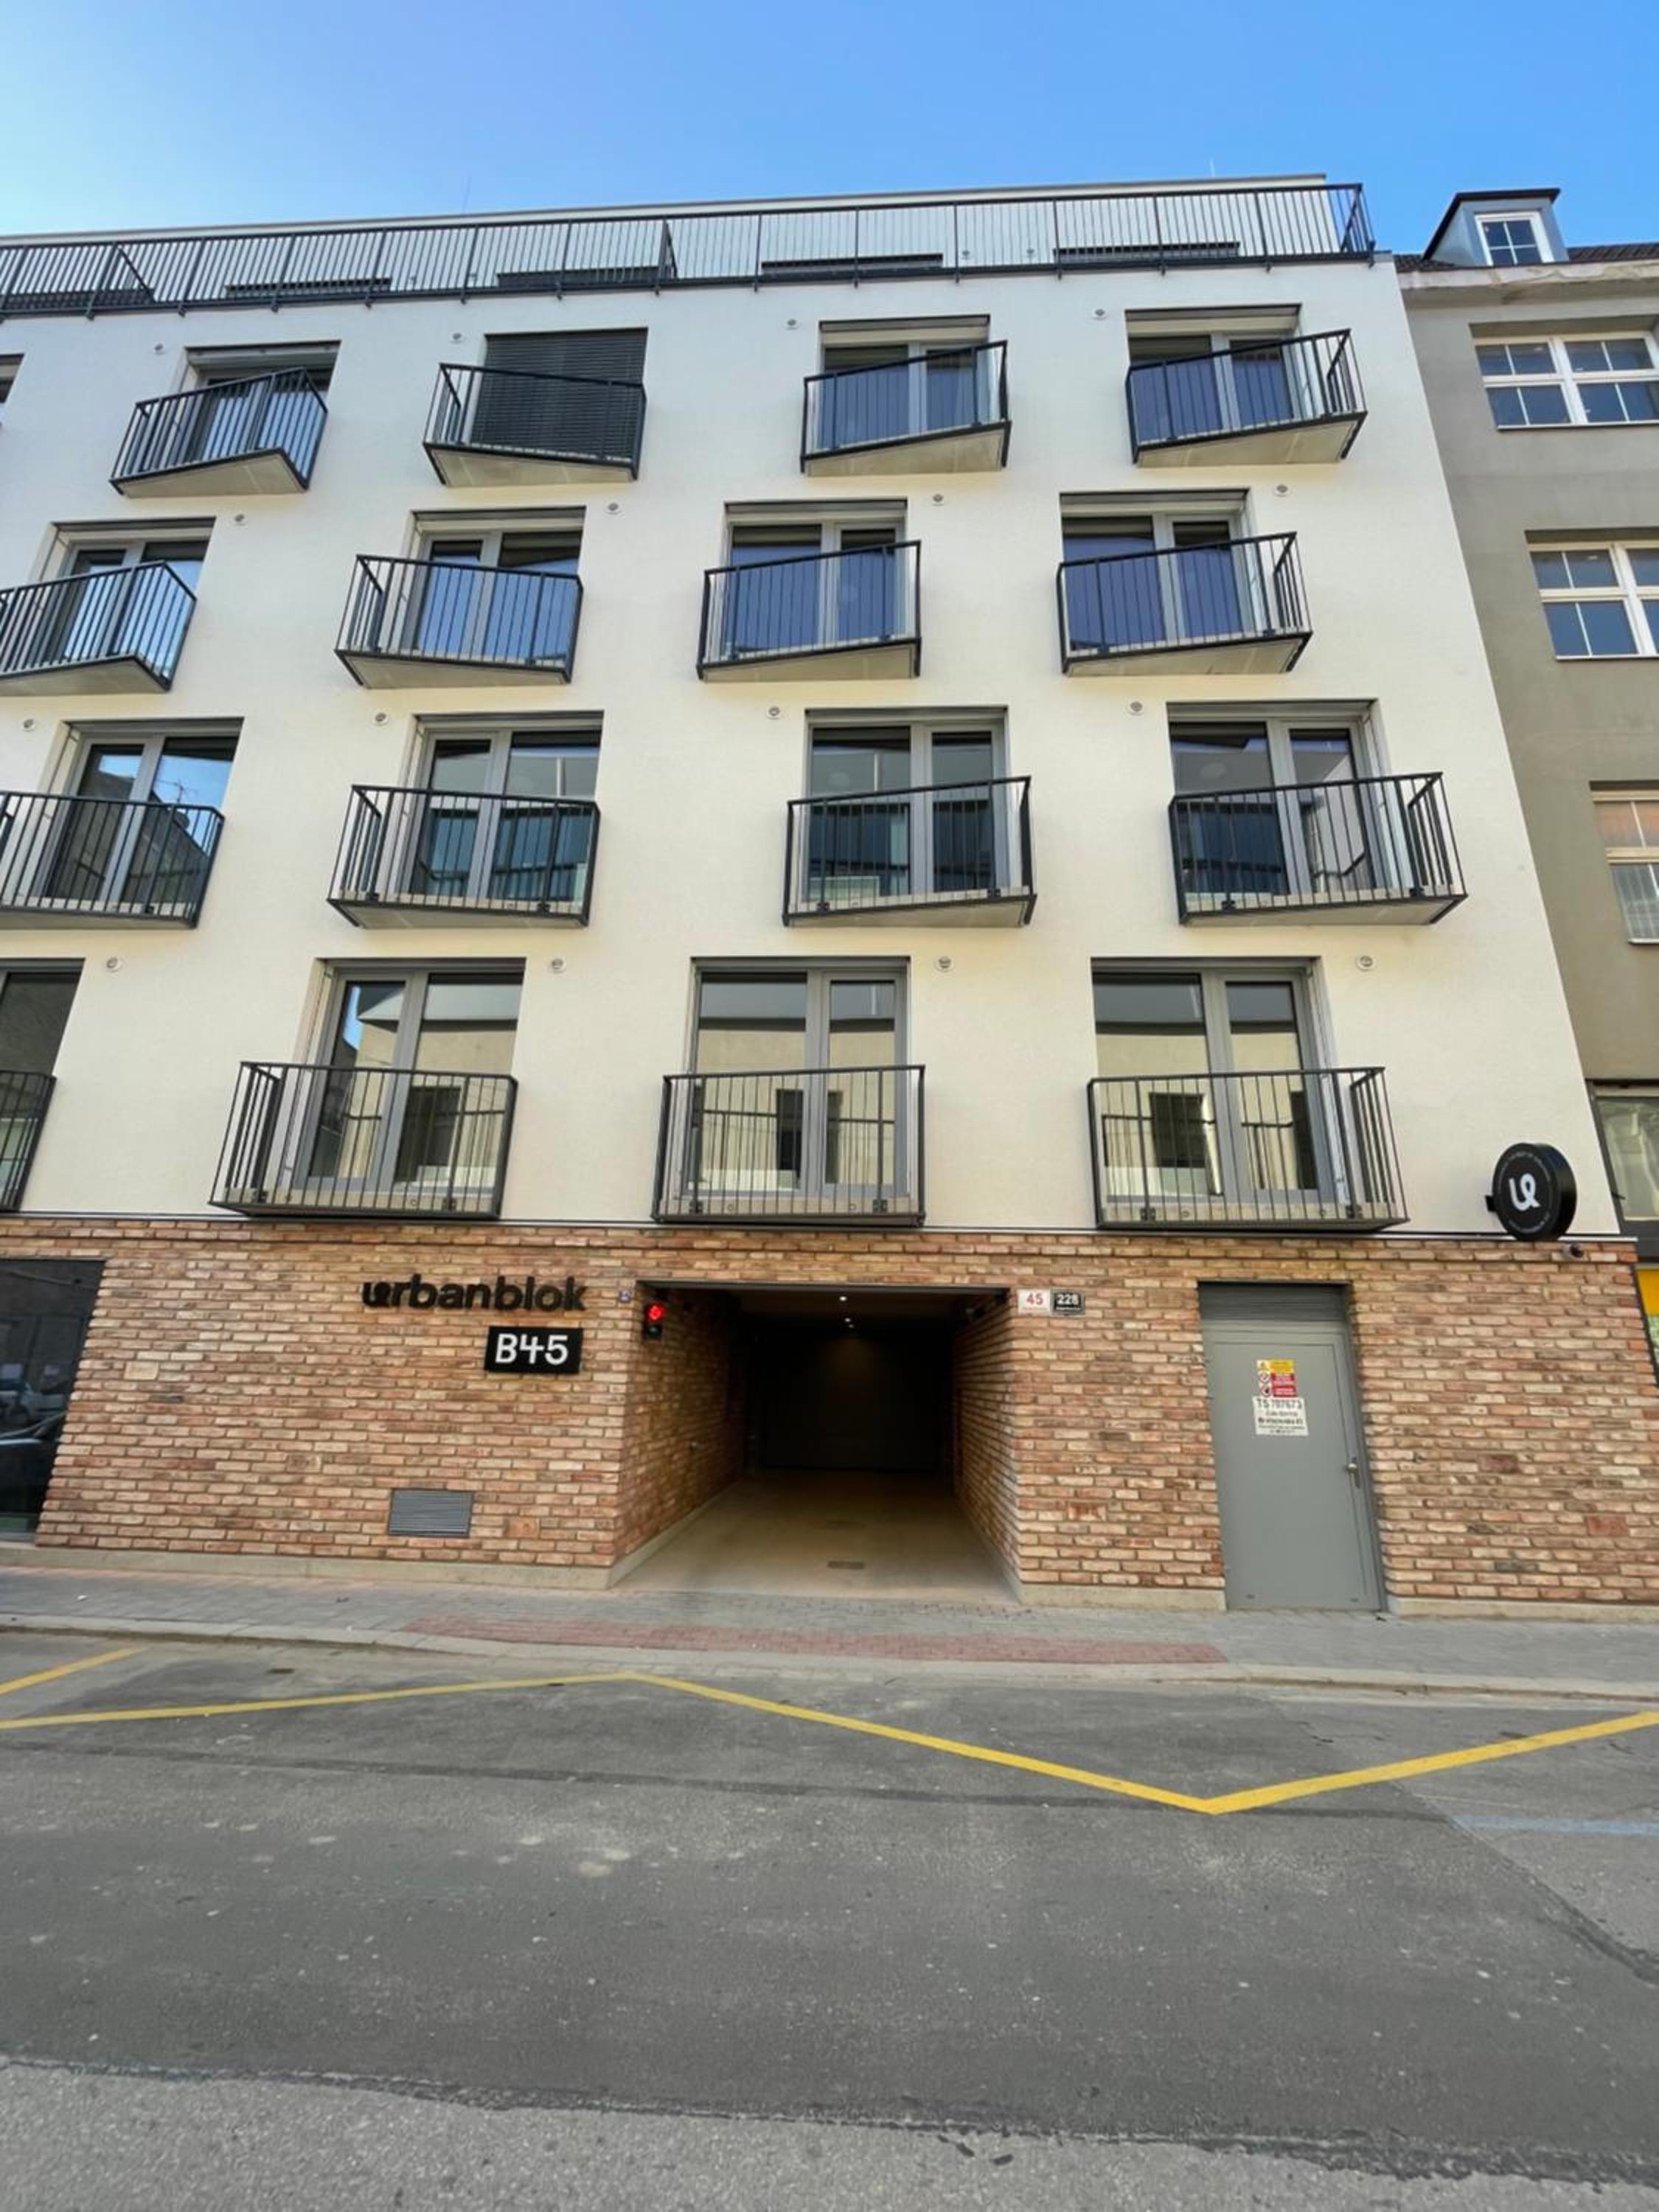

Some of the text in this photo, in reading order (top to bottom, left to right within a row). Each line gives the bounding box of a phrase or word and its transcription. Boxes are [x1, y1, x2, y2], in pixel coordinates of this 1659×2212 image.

[361, 1273, 589, 1312] urbanblok
[1026, 1291, 1043, 1305] 45
[495, 1332, 569, 1366] B45
